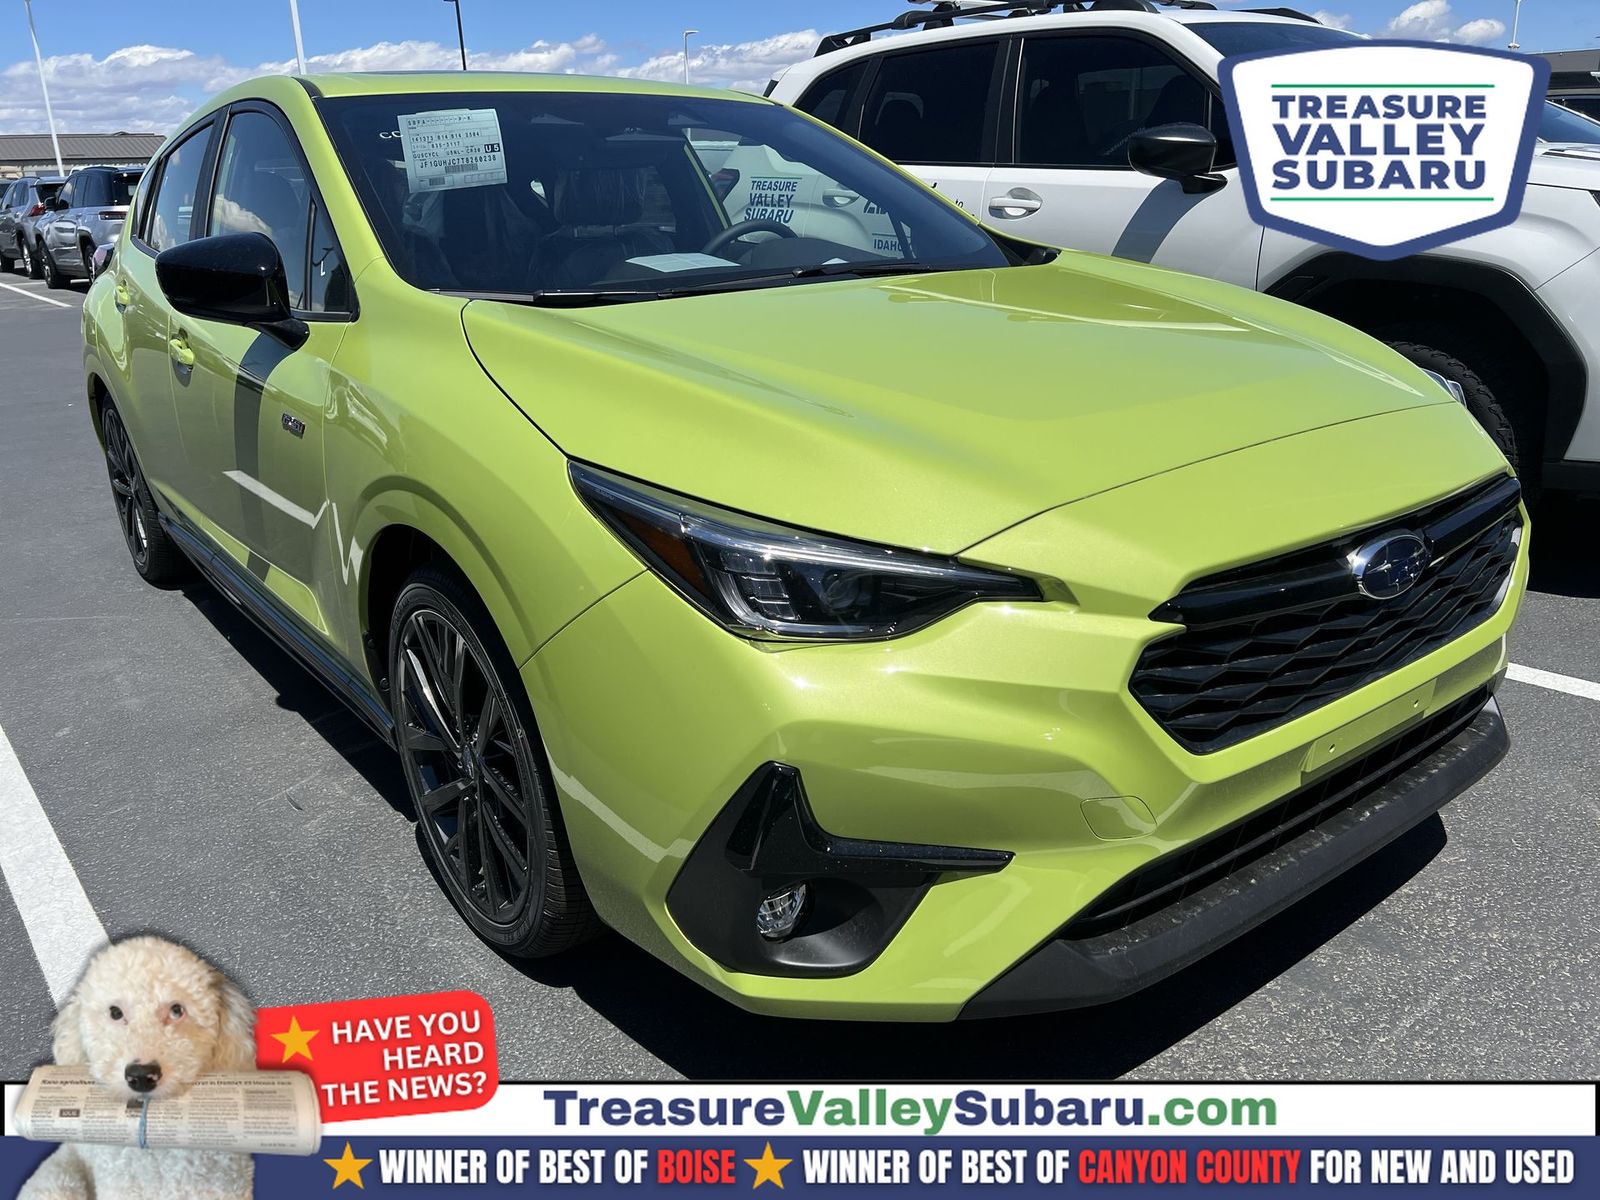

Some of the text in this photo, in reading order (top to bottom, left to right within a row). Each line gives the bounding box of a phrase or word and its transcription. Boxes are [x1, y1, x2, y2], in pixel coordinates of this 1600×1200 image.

[751, 180, 798, 192] TREASURE
[750, 193, 794, 208] VALLEY
[744, 207, 794, 224] SUBARU
